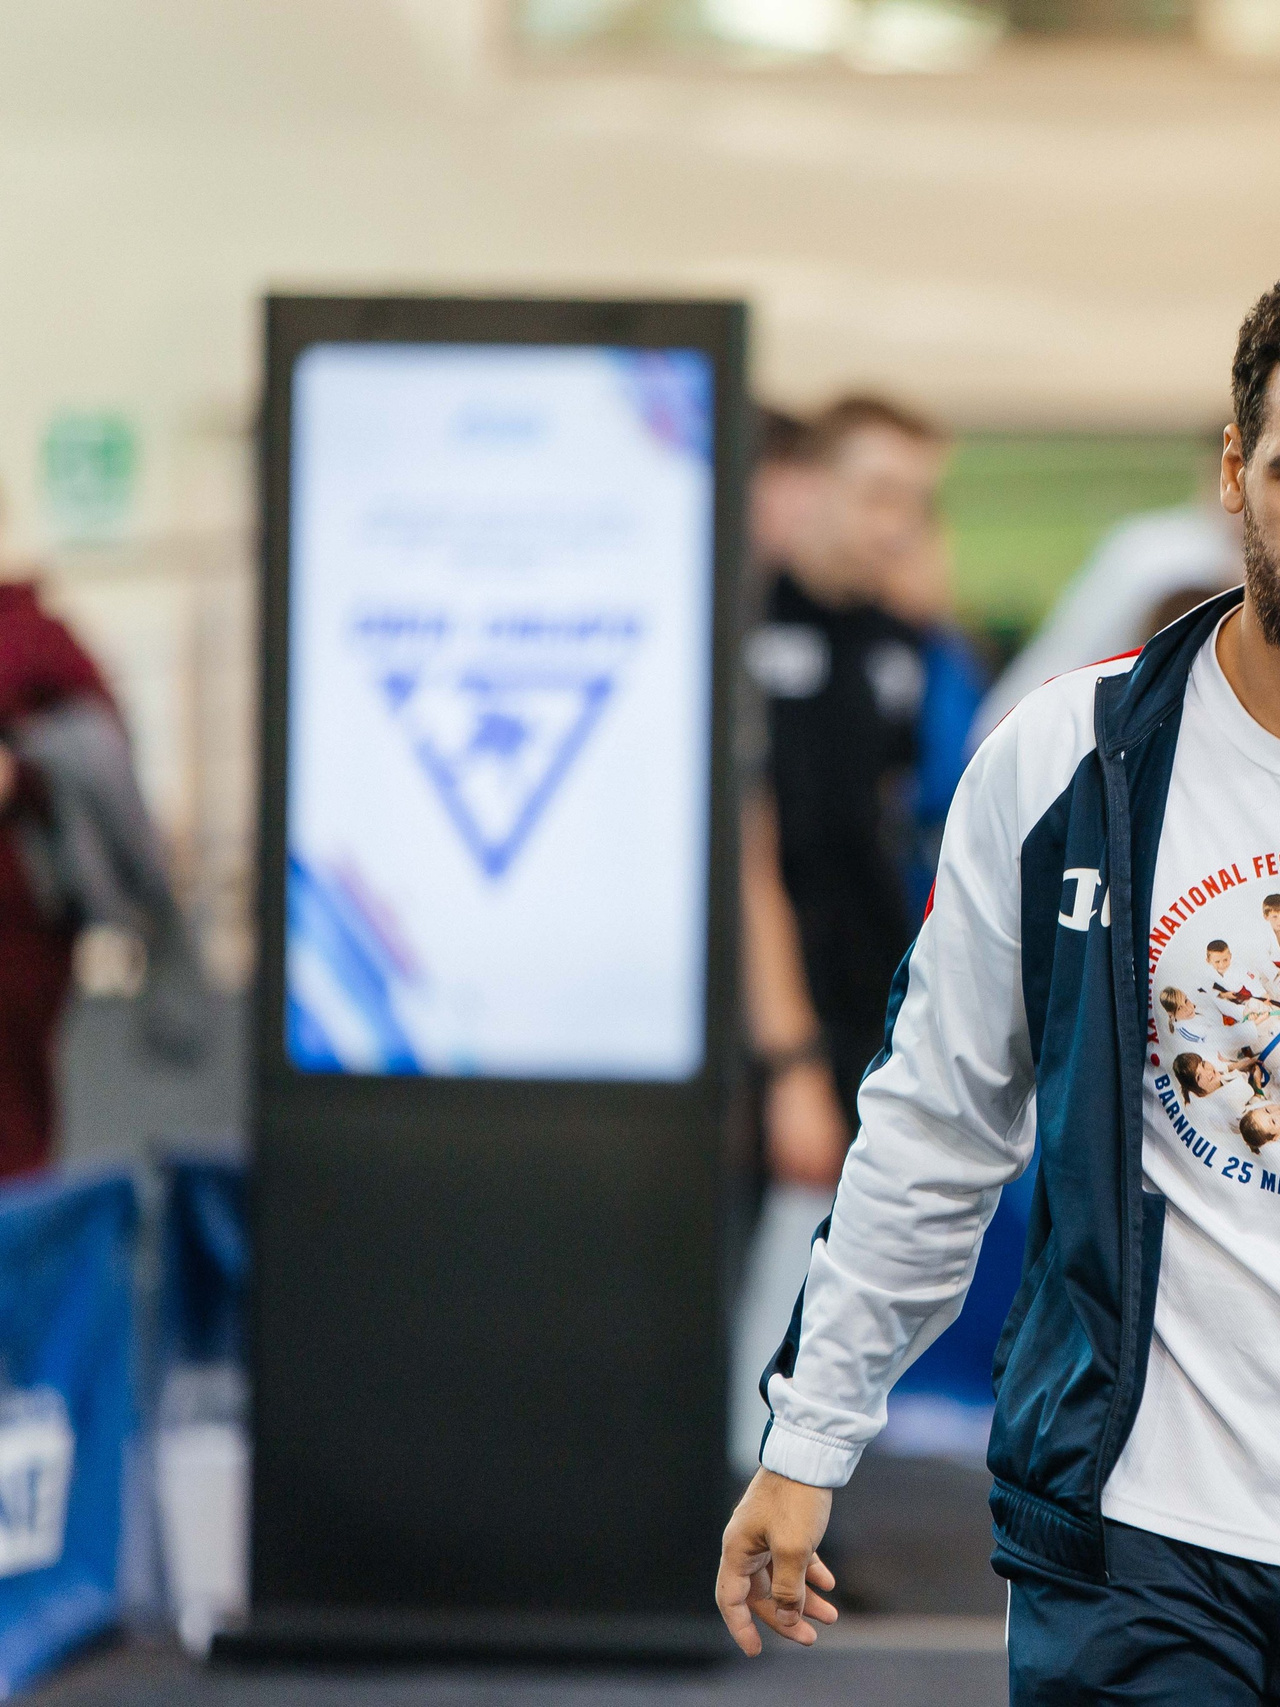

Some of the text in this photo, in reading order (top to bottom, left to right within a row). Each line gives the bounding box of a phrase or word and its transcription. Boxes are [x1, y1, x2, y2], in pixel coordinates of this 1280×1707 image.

[1148, 863, 1248, 1009] ERNATIONAL
[1154, 1073, 1218, 1168] BARNAUL
[1221, 1156, 1254, 1184] 25
